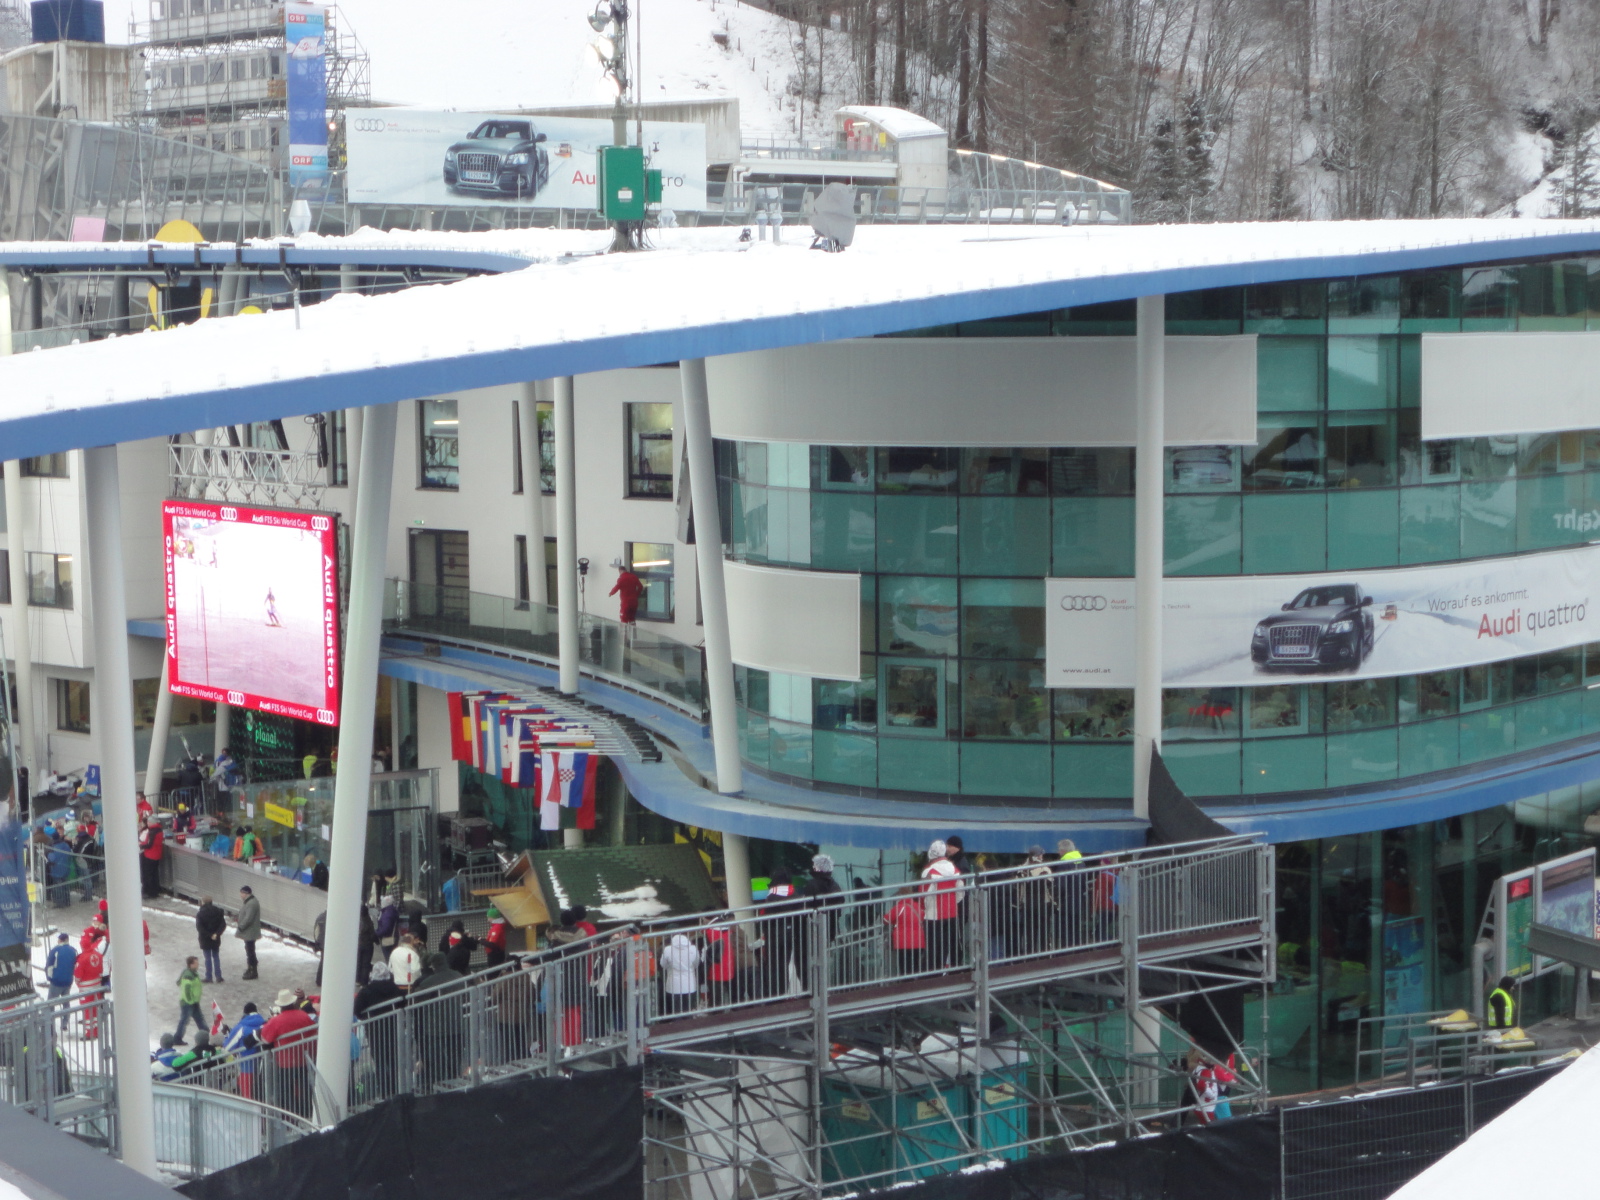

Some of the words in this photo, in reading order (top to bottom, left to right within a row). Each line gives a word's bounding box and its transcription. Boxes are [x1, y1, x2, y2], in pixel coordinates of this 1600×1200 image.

[289, 14, 305, 22] ORF
[293, 156, 311, 164] ORF
[572, 170, 596, 185] Au
[164, 505, 175, 514] Audi
[175, 507, 184, 515] FIS
[191, 508, 207, 517] World
[207, 510, 217, 518] Cup
[252, 514, 264, 523] Audi
[264, 516, 273, 524] FIS
[273, 516, 281, 525] Ski
[281, 518, 297, 526] World
[297, 519, 307, 528] Cup
[165, 535, 174, 609] quattro
[324, 554, 333, 603] Audi
[1427, 594, 1469, 612] Worauf
[1471, 595, 1482, 607] es
[1484, 588, 1530, 605] ankommt.
[1477, 608, 1521, 639] Audi
[1526, 602, 1587, 637] quattro
[168, 614, 176, 659] Audi
[325, 608, 334, 689] quattro
[170, 684, 182, 693] Audi
[182, 686, 190, 694] FIS
[190, 687, 198, 695] Ski
[198, 689, 214, 699] World
[213, 691, 224, 701] Cup
[259, 701, 271, 710] Audi
[271, 703, 280, 712] FIS
[280, 705, 288, 713] Ski
[288, 707, 303, 717] World
[302, 710, 313, 719] Cup
